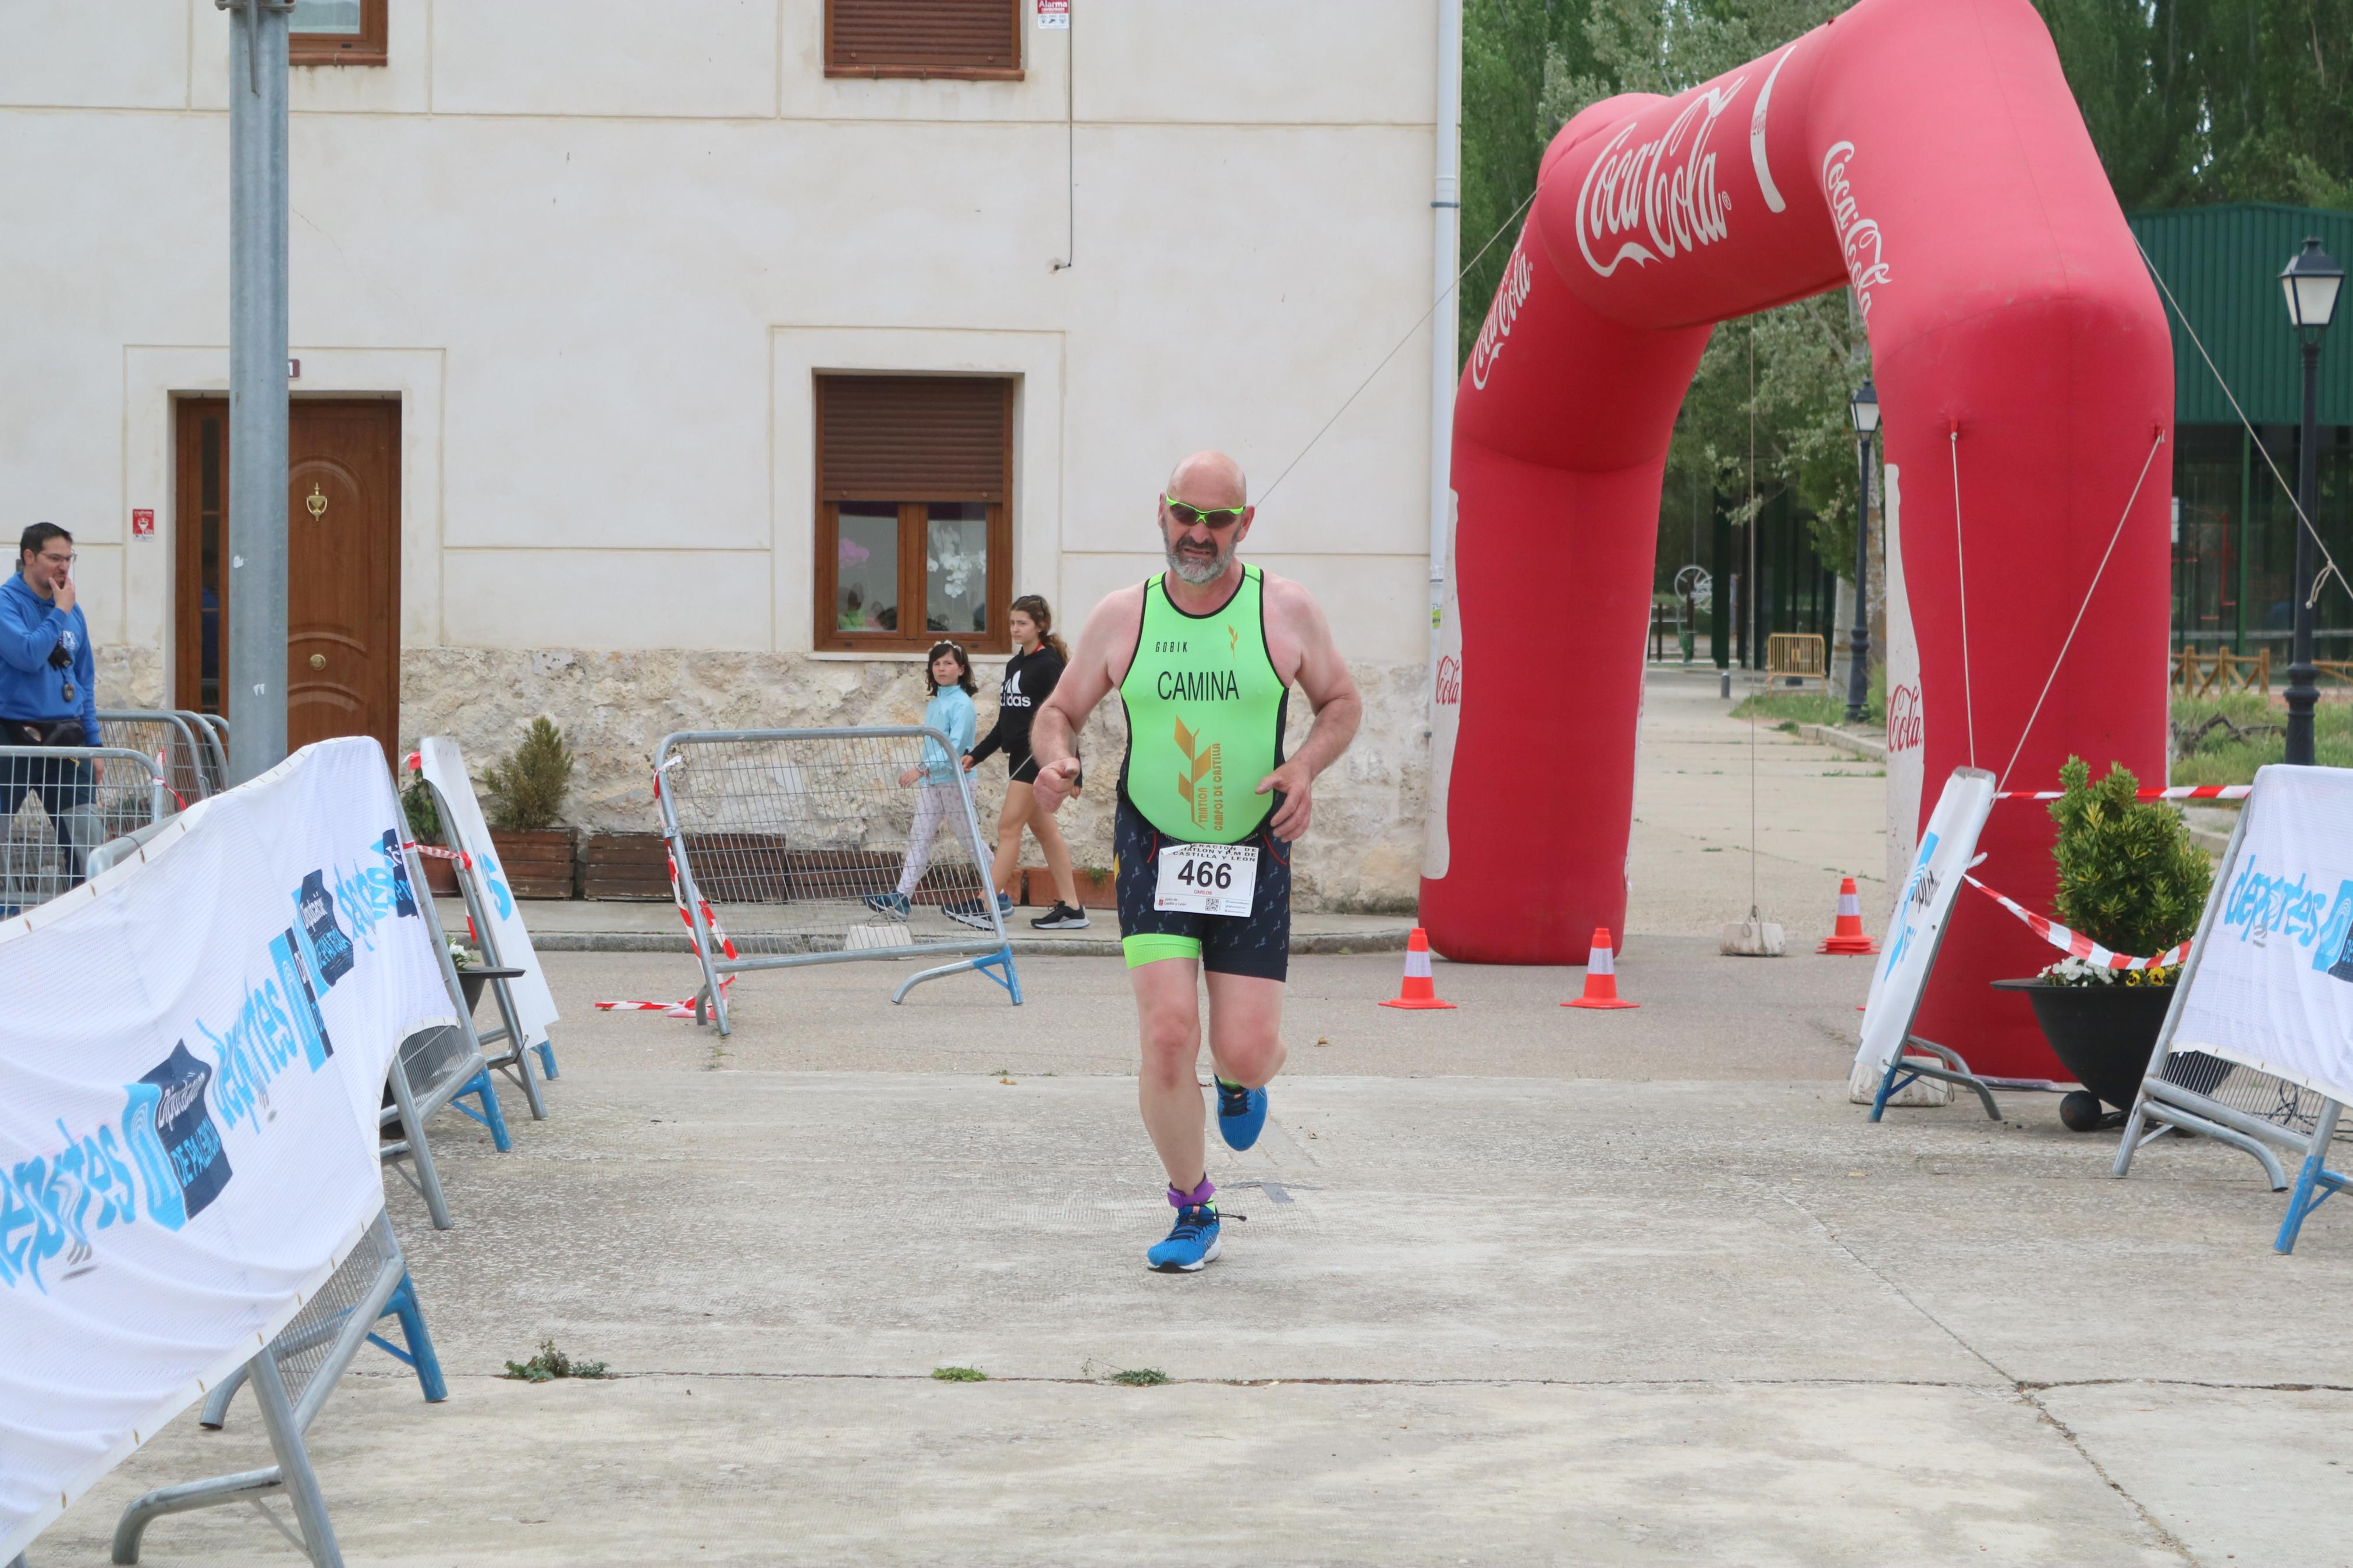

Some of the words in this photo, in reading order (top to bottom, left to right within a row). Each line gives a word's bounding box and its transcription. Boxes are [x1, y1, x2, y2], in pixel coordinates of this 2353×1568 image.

[1576, 76, 1746, 278] Coca-Cola
[1155, 642, 1187, 652] GOBIK
[1158, 670, 1240, 701] CAMINA
[1212, 743, 1222, 783] CASTILLA
[1213, 785, 1223, 797] DE
[1214, 799, 1223, 831] CAMPOS
[1173, 851, 1217, 859] CASTILLA
[1177, 859, 1232, 890] 466
[2224, 854, 2327, 947] deportes
[170, 1147, 194, 1188] DE
[182, 1115, 222, 1176] PALENCIA
[0, 1118, 136, 1296] eportes
